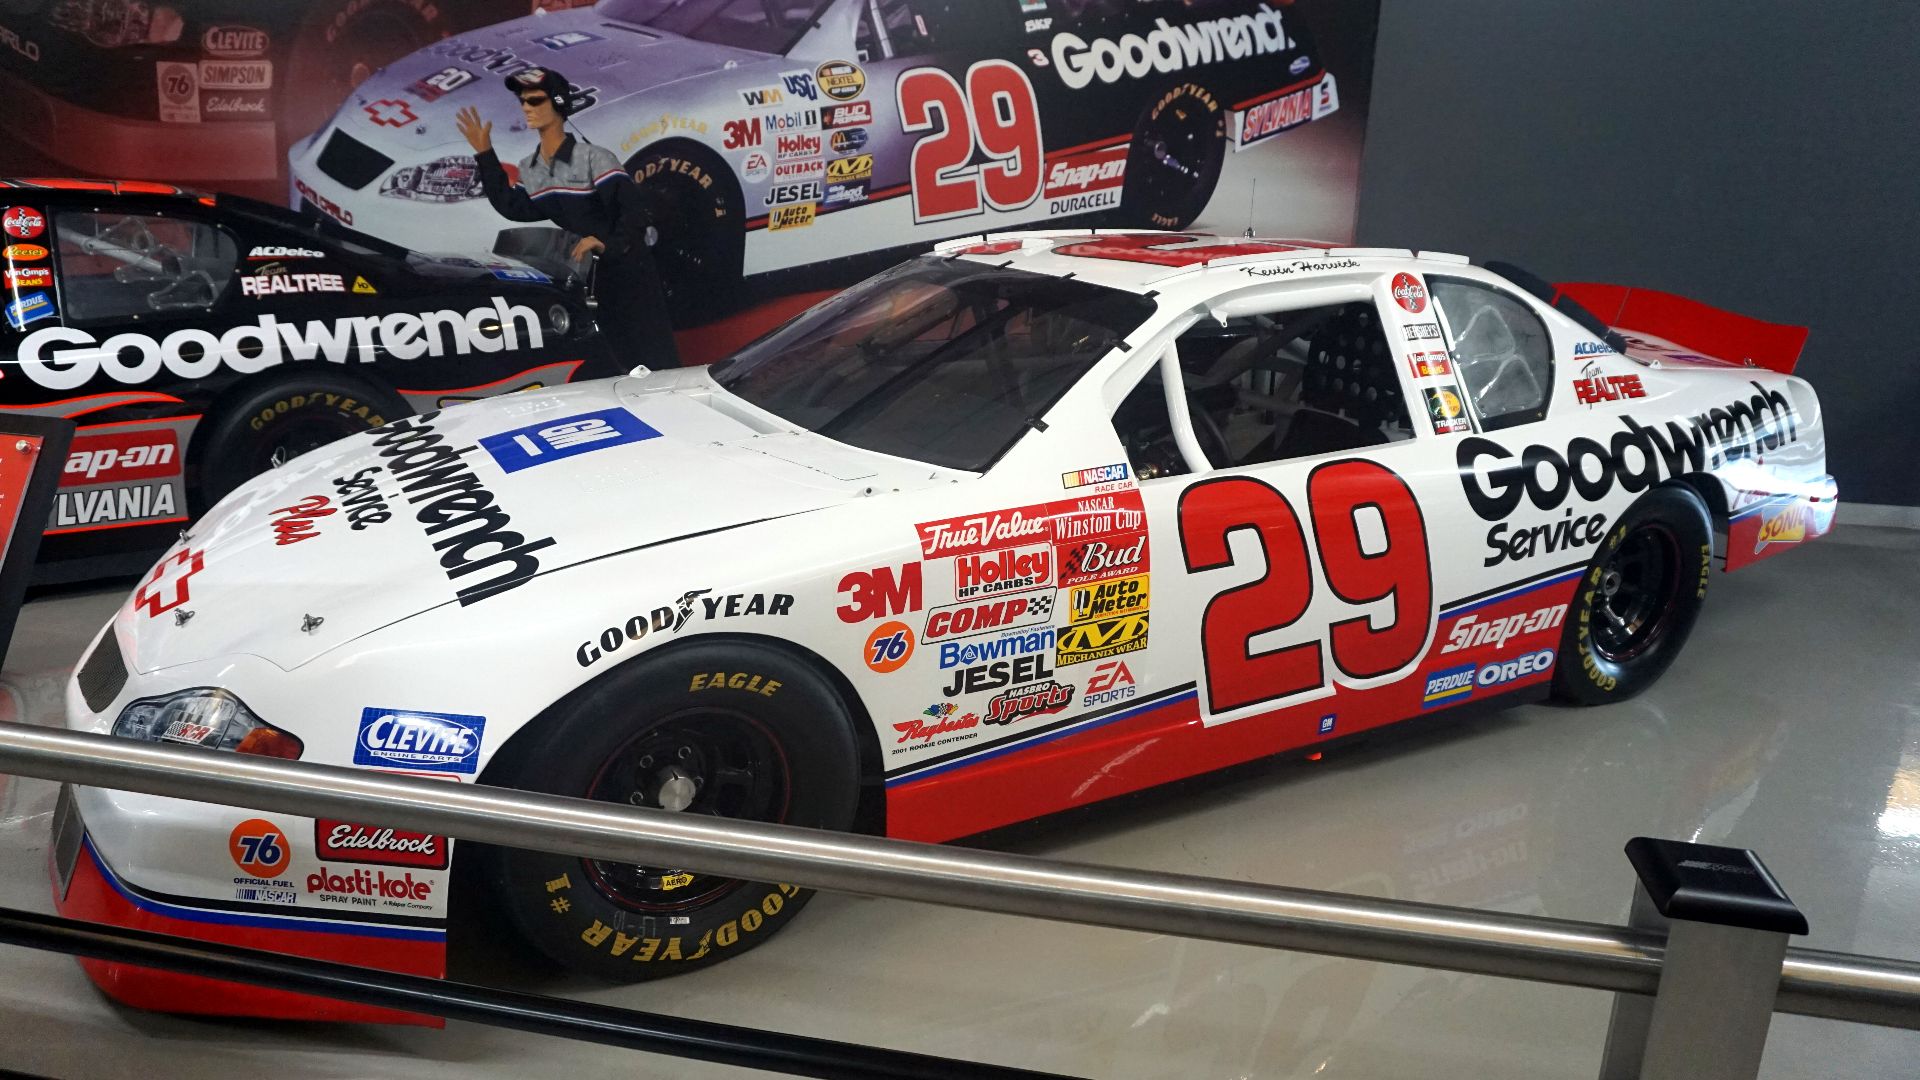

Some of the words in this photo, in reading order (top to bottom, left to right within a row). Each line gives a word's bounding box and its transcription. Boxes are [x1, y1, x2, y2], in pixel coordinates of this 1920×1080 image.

[206, 26, 264, 50] CLEVITE
[168, 75, 189, 95] 76
[204, 65, 265, 84] SIMPSON
[783, 73, 818, 101] USG
[827, 75, 857, 87] NEXTEL
[743, 88, 783, 106] WM
[766, 110, 801, 131] Mobil
[1242, 88, 1312, 142] SYLVANIA
[723, 117, 762, 150] 3M
[778, 134, 821, 154] Holley
[896, 59, 1044, 224] 29
[634, 157, 713, 190] ODYEAR
[747, 154, 768, 170] EA
[775, 161, 824, 176] OUTBACK
[1045, 158, 1127, 189] Snap-on
[765, 182, 822, 205] JESEL
[1050, 191, 1116, 215] DURACELL
[781, 213, 811, 226] Meter
[784, 205, 808, 217] Auto
[249, 246, 326, 258] ACDelco
[1240, 266, 1294, 277] Kevin
[241, 273, 346, 296] REALTREE
[18, 295, 544, 390] Goodwrench
[1573, 374, 1648, 405] REALTREE
[250, 392, 385, 431] GOODYEAR
[64, 441, 174, 478] ap-on
[1456, 381, 1797, 521] Goodwrench
[1083, 465, 1125, 484] NASCAR
[1095, 483, 1115, 493] RACE
[1118, 481, 1133, 490] CAR
[333, 466, 399, 531] Service
[1077, 496, 1115, 512] NASCAR
[268, 495, 338, 546] Plus
[924, 523, 979, 555] True
[963, 511, 1045, 546] Value
[1055, 513, 1112, 540] Winston
[1115, 508, 1141, 531] Cup
[1484, 508, 1607, 567] Service
[1081, 536, 1147, 572] Bud
[957, 549, 1049, 588] Holley
[1066, 573, 1098, 585] POLE
[1100, 566, 1139, 580] AWARD
[836, 561, 923, 624] 3M
[958, 586, 980, 597] HP
[982, 577, 1034, 593] CARBS
[1095, 580, 1140, 600] Auto
[1177, 457, 1434, 716] 29
[1090, 592, 1148, 616] Meter
[576, 589, 795, 668] GOODYEAR
[925, 598, 1029, 639] COMP
[1440, 603, 1568, 655] Snap-on
[872, 631, 907, 664] 76
[1057, 648, 1114, 666] MECHANIX
[1116, 637, 1148, 654] WEAR
[943, 653, 1054, 698] JESEL
[1085, 660, 1136, 695] EA
[1477, 650, 1554, 685] OREO
[688, 672, 784, 697] EAGLE
[1008, 683, 1050, 698] HASBRO
[1426, 669, 1475, 694] PERDUE
[986, 686, 1074, 721] Sports
[1084, 685, 1136, 707] SPORTS
[180, 723, 211, 740] RCR
[367, 714, 473, 755] CLEVITE
[892, 745, 908, 755] 2001
[909, 741, 936, 752] ROOKIE
[937, 733, 978, 746] CONTENDER
[373, 751, 417, 759] ENGINE
[422, 754, 460, 762] PARTS
[240, 833, 281, 865] 76
[328, 824, 435, 855] Edelbrock
[234, 877, 271, 886] OFFICIAL
[307, 867, 431, 900] plasti-kote
[665, 876, 688, 887] AERO
[255, 889, 296, 903] NASCAR
[319, 894, 349, 904] SPRAY
[352, 896, 377, 906] PAINT
